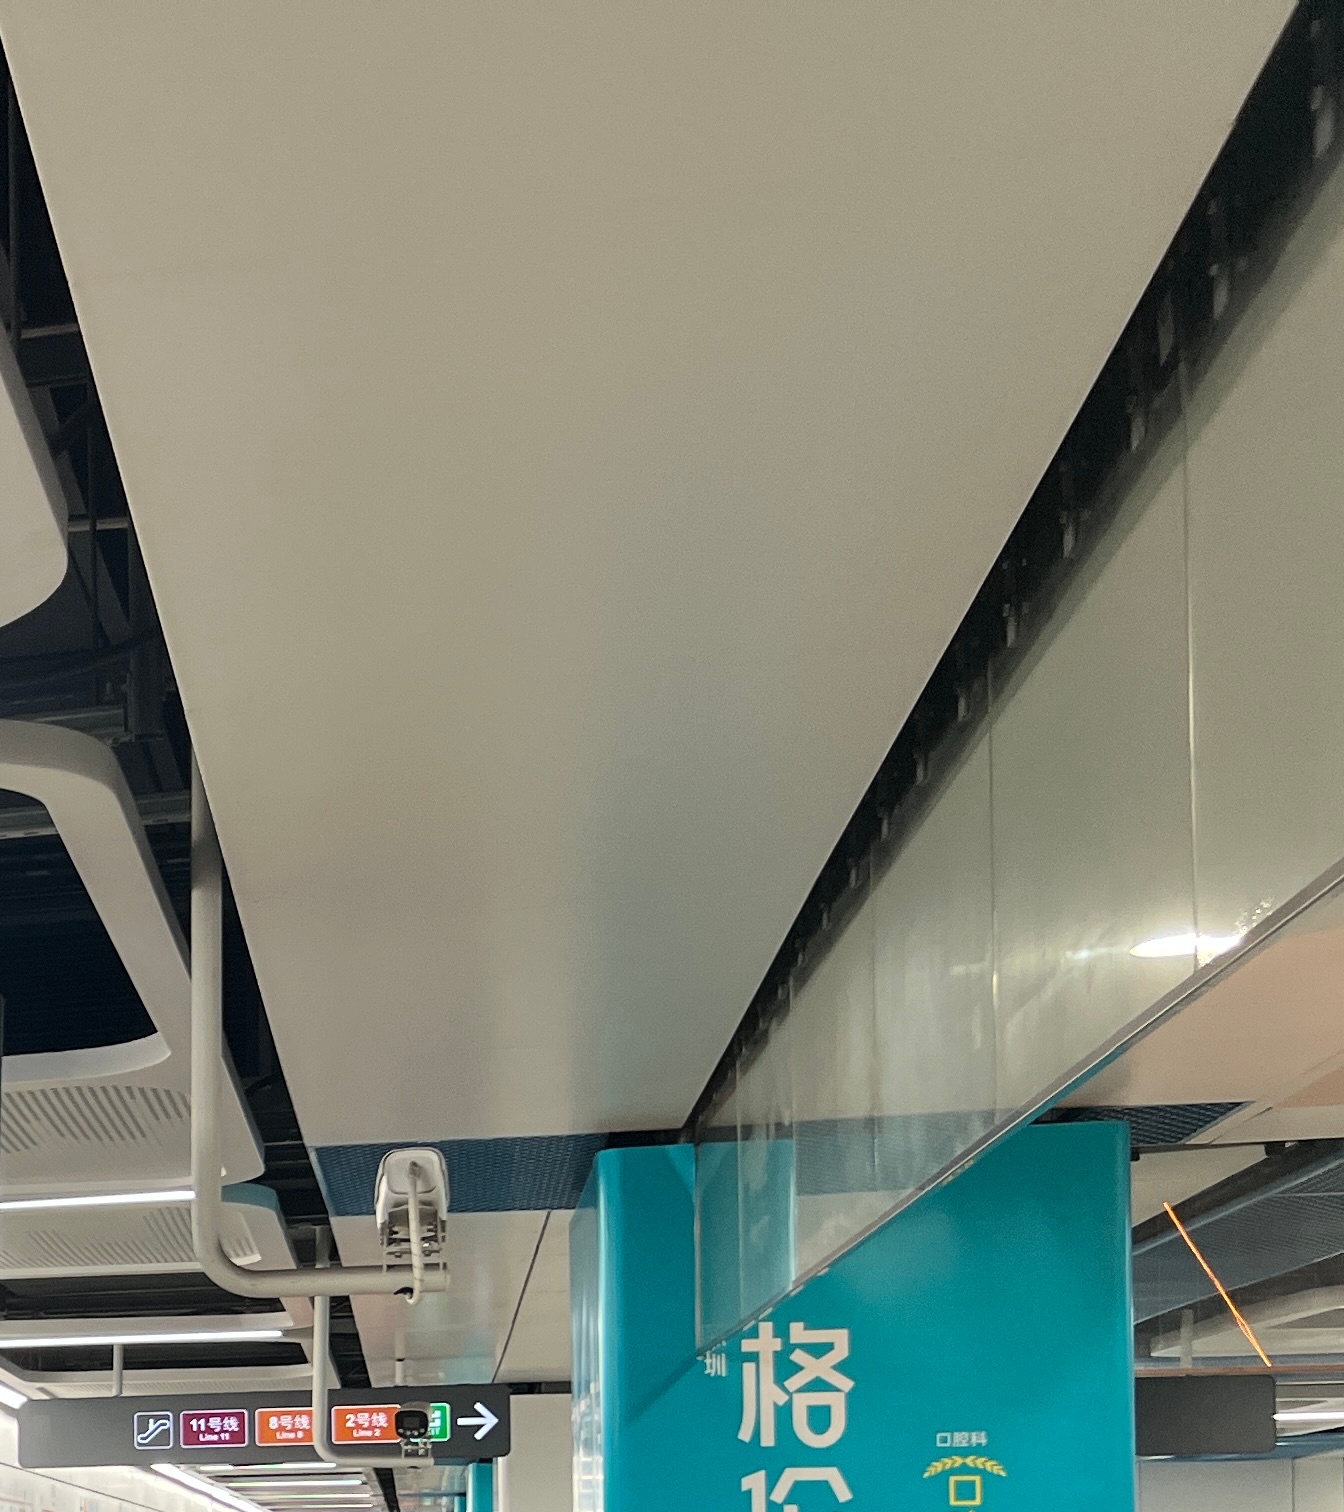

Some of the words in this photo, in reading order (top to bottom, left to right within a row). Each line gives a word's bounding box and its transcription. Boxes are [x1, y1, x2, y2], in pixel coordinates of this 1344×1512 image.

[189, 1415, 240, 1433] 11号线
[268, 1413, 311, 1431] 8号线
[345, 1412, 389, 1429] 2号线
